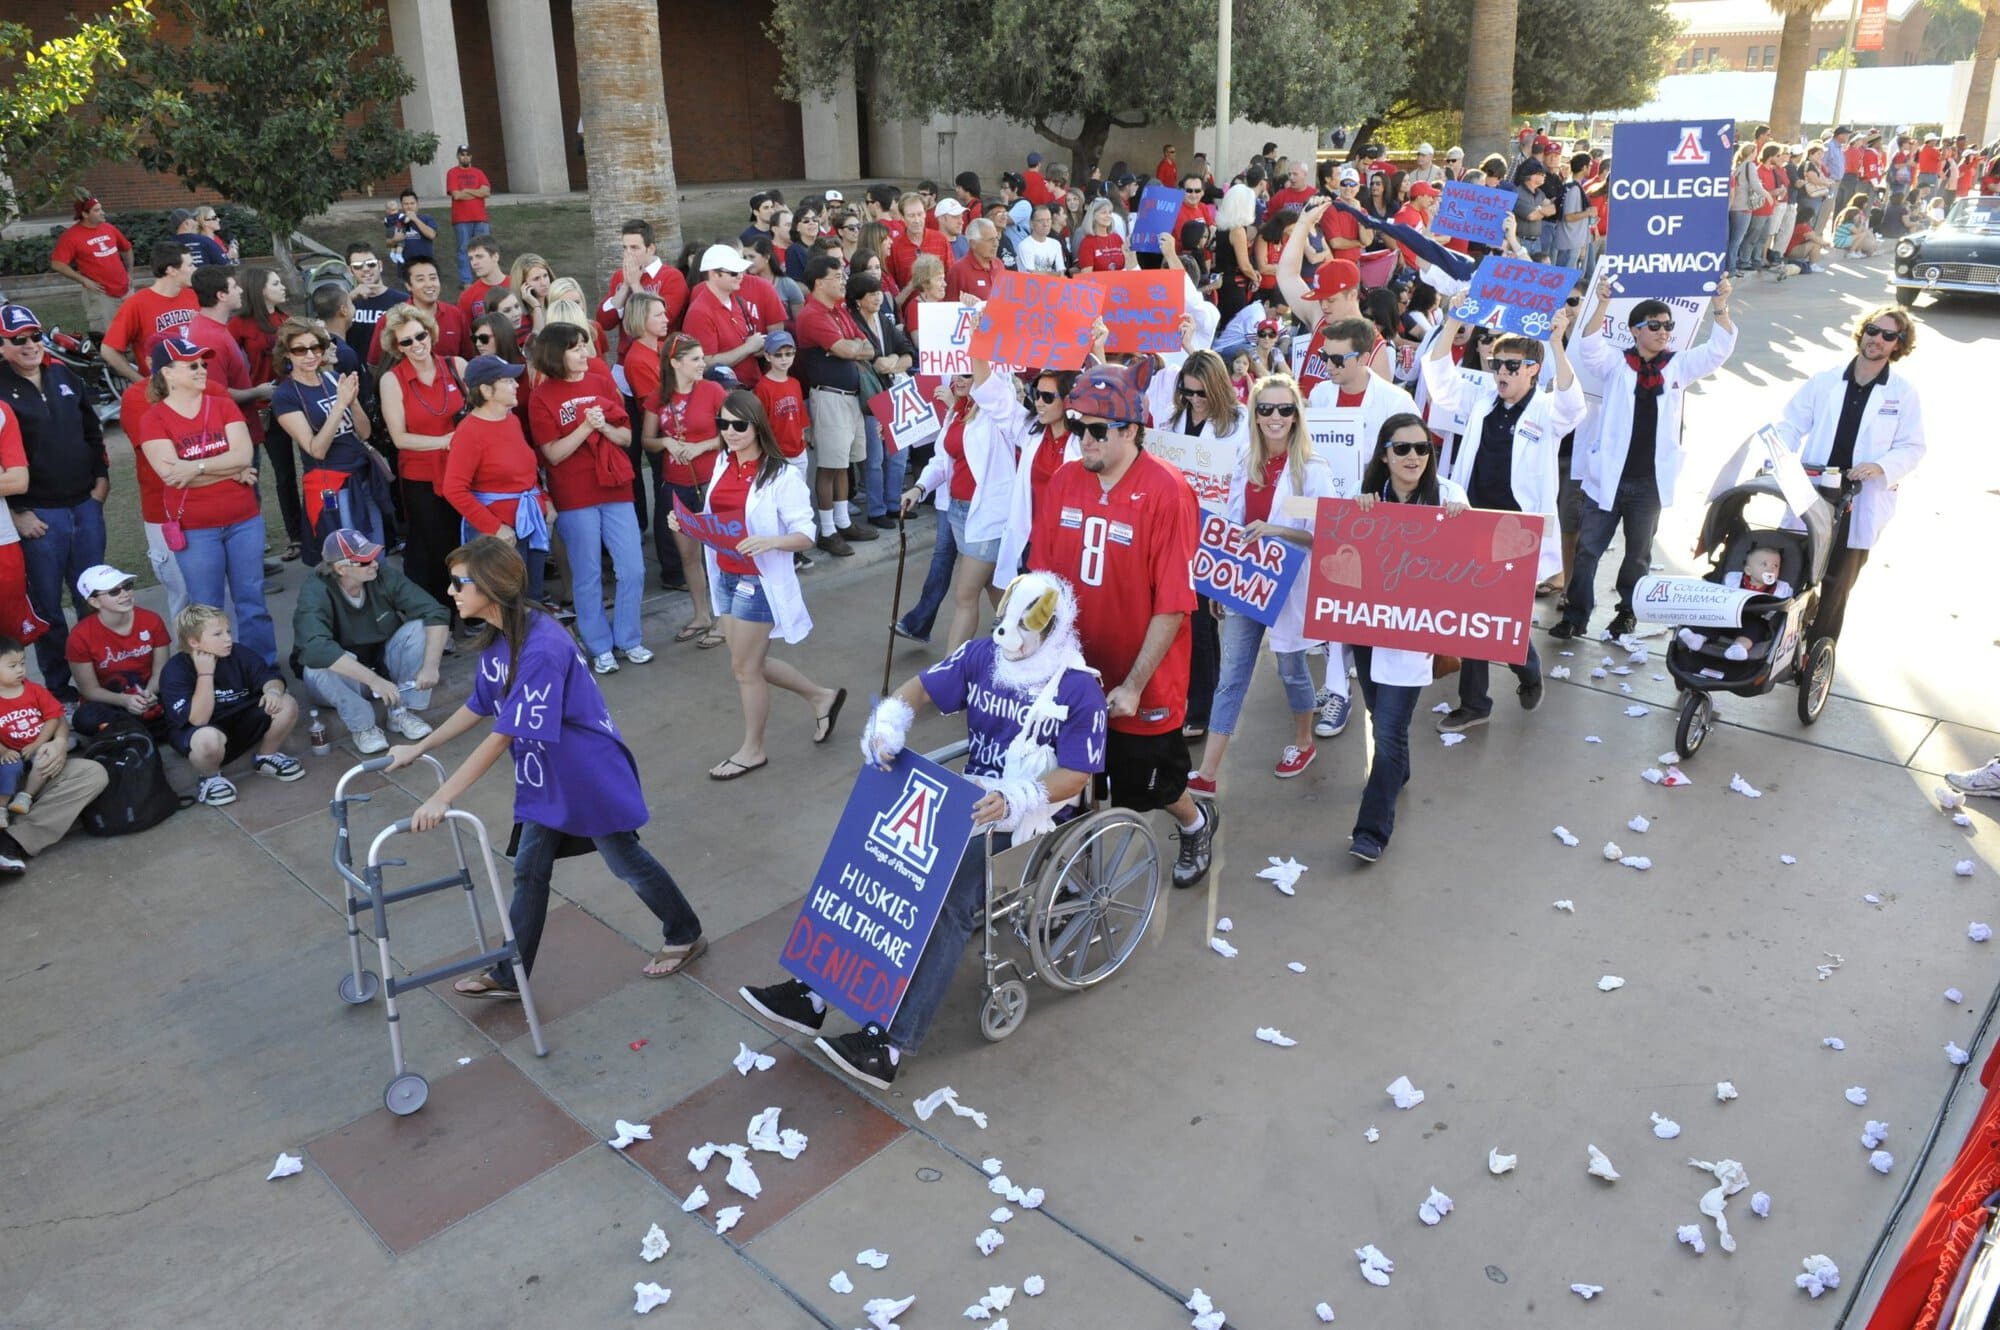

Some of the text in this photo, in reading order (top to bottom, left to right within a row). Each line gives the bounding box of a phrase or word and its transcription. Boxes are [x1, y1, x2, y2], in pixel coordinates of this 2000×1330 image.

[1667, 127, 1711, 165] A
[1612, 176, 1729, 200] COLLEGE
[1472, 205, 1496, 221] for
[1647, 215, 1684, 236] OF
[1493, 263, 1565, 289] LET'S GO
[1604, 251, 1726, 274] PHARMACY
[1481, 284, 1556, 312] WILDCATS
[157, 309, 194, 333] ARIZO
[1015, 309, 1057, 342] FOR
[1102, 306, 1177, 325] ARMACY
[1480, 305, 1507, 329] A
[992, 333, 1072, 370] LIFE
[890, 377, 936, 436] A
[703, 514, 742, 537] The
[1321, 503, 1441, 544] Love
[1080, 516, 1107, 587] 8
[1202, 514, 1286, 577] BEAR
[1192, 549, 1278, 611] DOWN
[1375, 543, 1503, 591] Your
[1646, 581, 1672, 602] A
[1672, 592, 1731, 604] PHARMACY
[1673, 583, 1719, 593] COLLEGE
[1315, 597, 1523, 645] PHARMACIST!
[1657, 613, 1688, 621] UNIVERSITY
[523, 682, 552, 702] W
[514, 702, 548, 730] 15
[1087, 738, 1105, 765] W
[868, 768, 948, 875] A
[864, 840, 889, 863] College
[839, 862, 919, 931] HUSKIES
[811, 885, 913, 969] HEALTHCARE
[786, 915, 909, 1023] DENIED!
